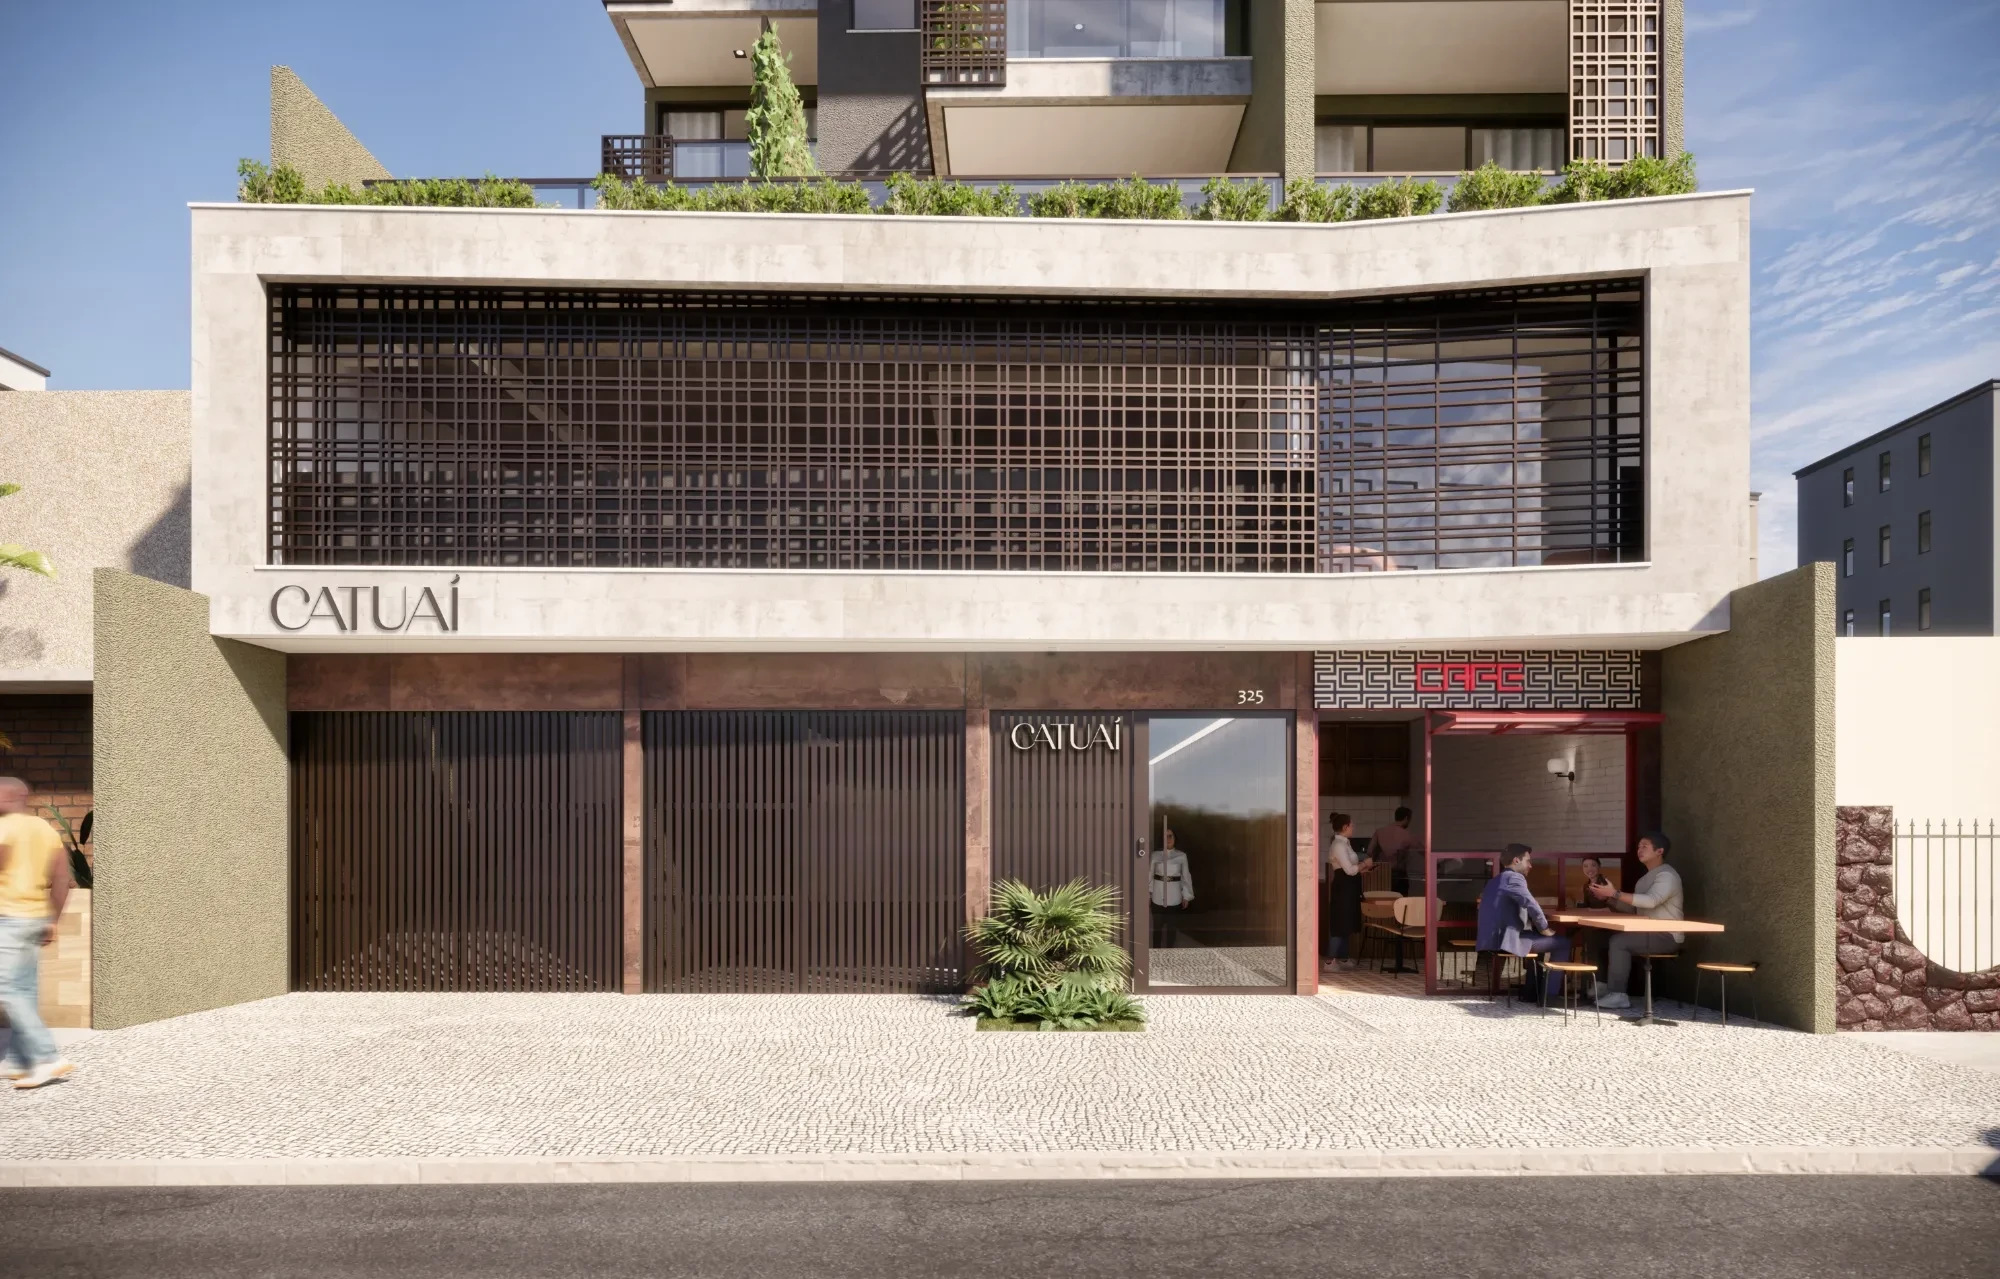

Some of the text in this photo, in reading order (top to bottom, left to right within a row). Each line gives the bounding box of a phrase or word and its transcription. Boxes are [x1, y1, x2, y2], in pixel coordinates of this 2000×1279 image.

[270, 573, 461, 631] CATUAÍ
[1237, 689, 1264, 705] 325
[1011, 716, 1121, 750] CATUAÍ
